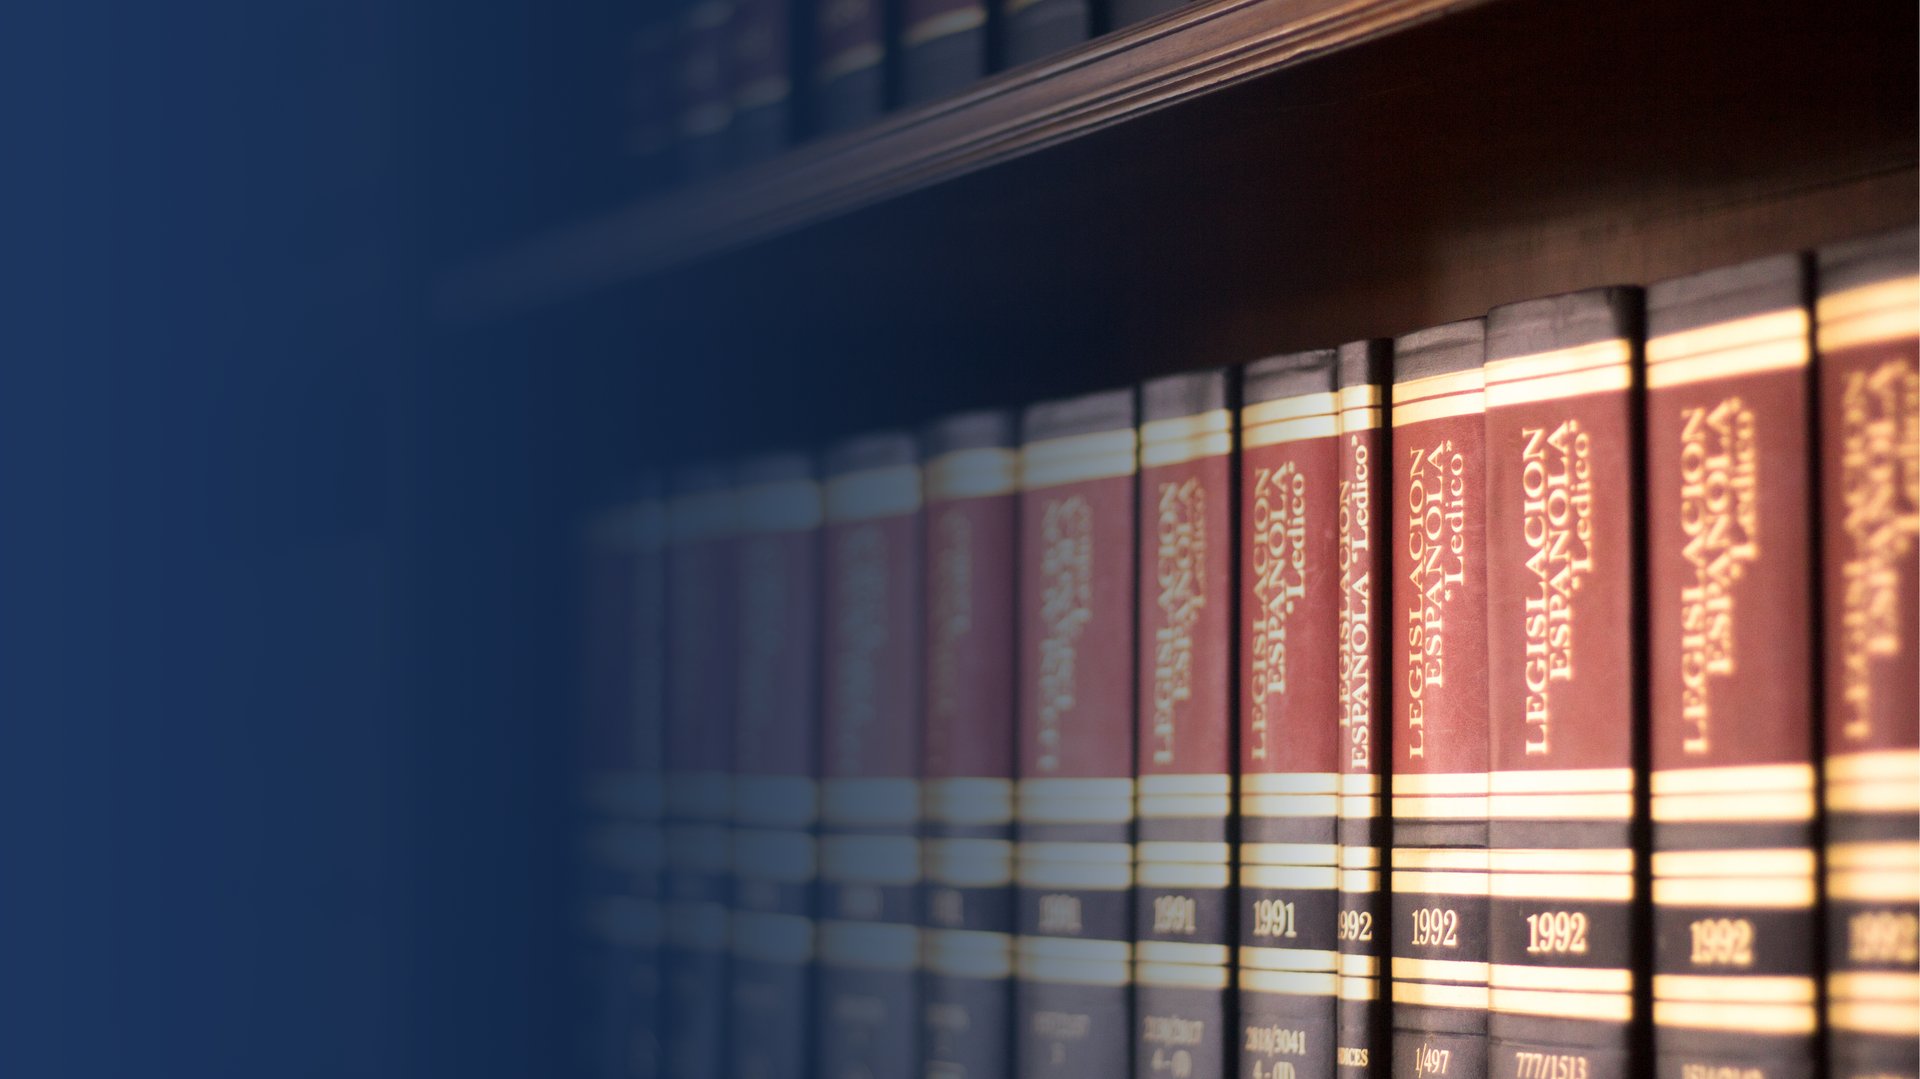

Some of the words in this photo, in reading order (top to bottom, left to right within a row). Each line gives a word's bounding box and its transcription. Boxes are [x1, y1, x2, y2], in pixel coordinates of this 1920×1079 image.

[1424, 440, 1444, 688] ESPAÑOLA
[1681, 407, 1708, 754] LEGISLACION
[1409, 446, 1424, 758] LEGISLACION
[1522, 428, 1548, 755] LEGISLACION
[1252, 468, 1270, 759] LEGISLACION
[1253, 900, 1297, 938] 1991
[1338, 910, 1373, 941] 992
[1412, 908, 1457, 946] 1992
[1526, 912, 1588, 953] 1992
[1690, 918, 1753, 964] 1992
[1415, 1043, 1449, 1078] 1/497
[1516, 1052, 1588, 1079] 777/1513
